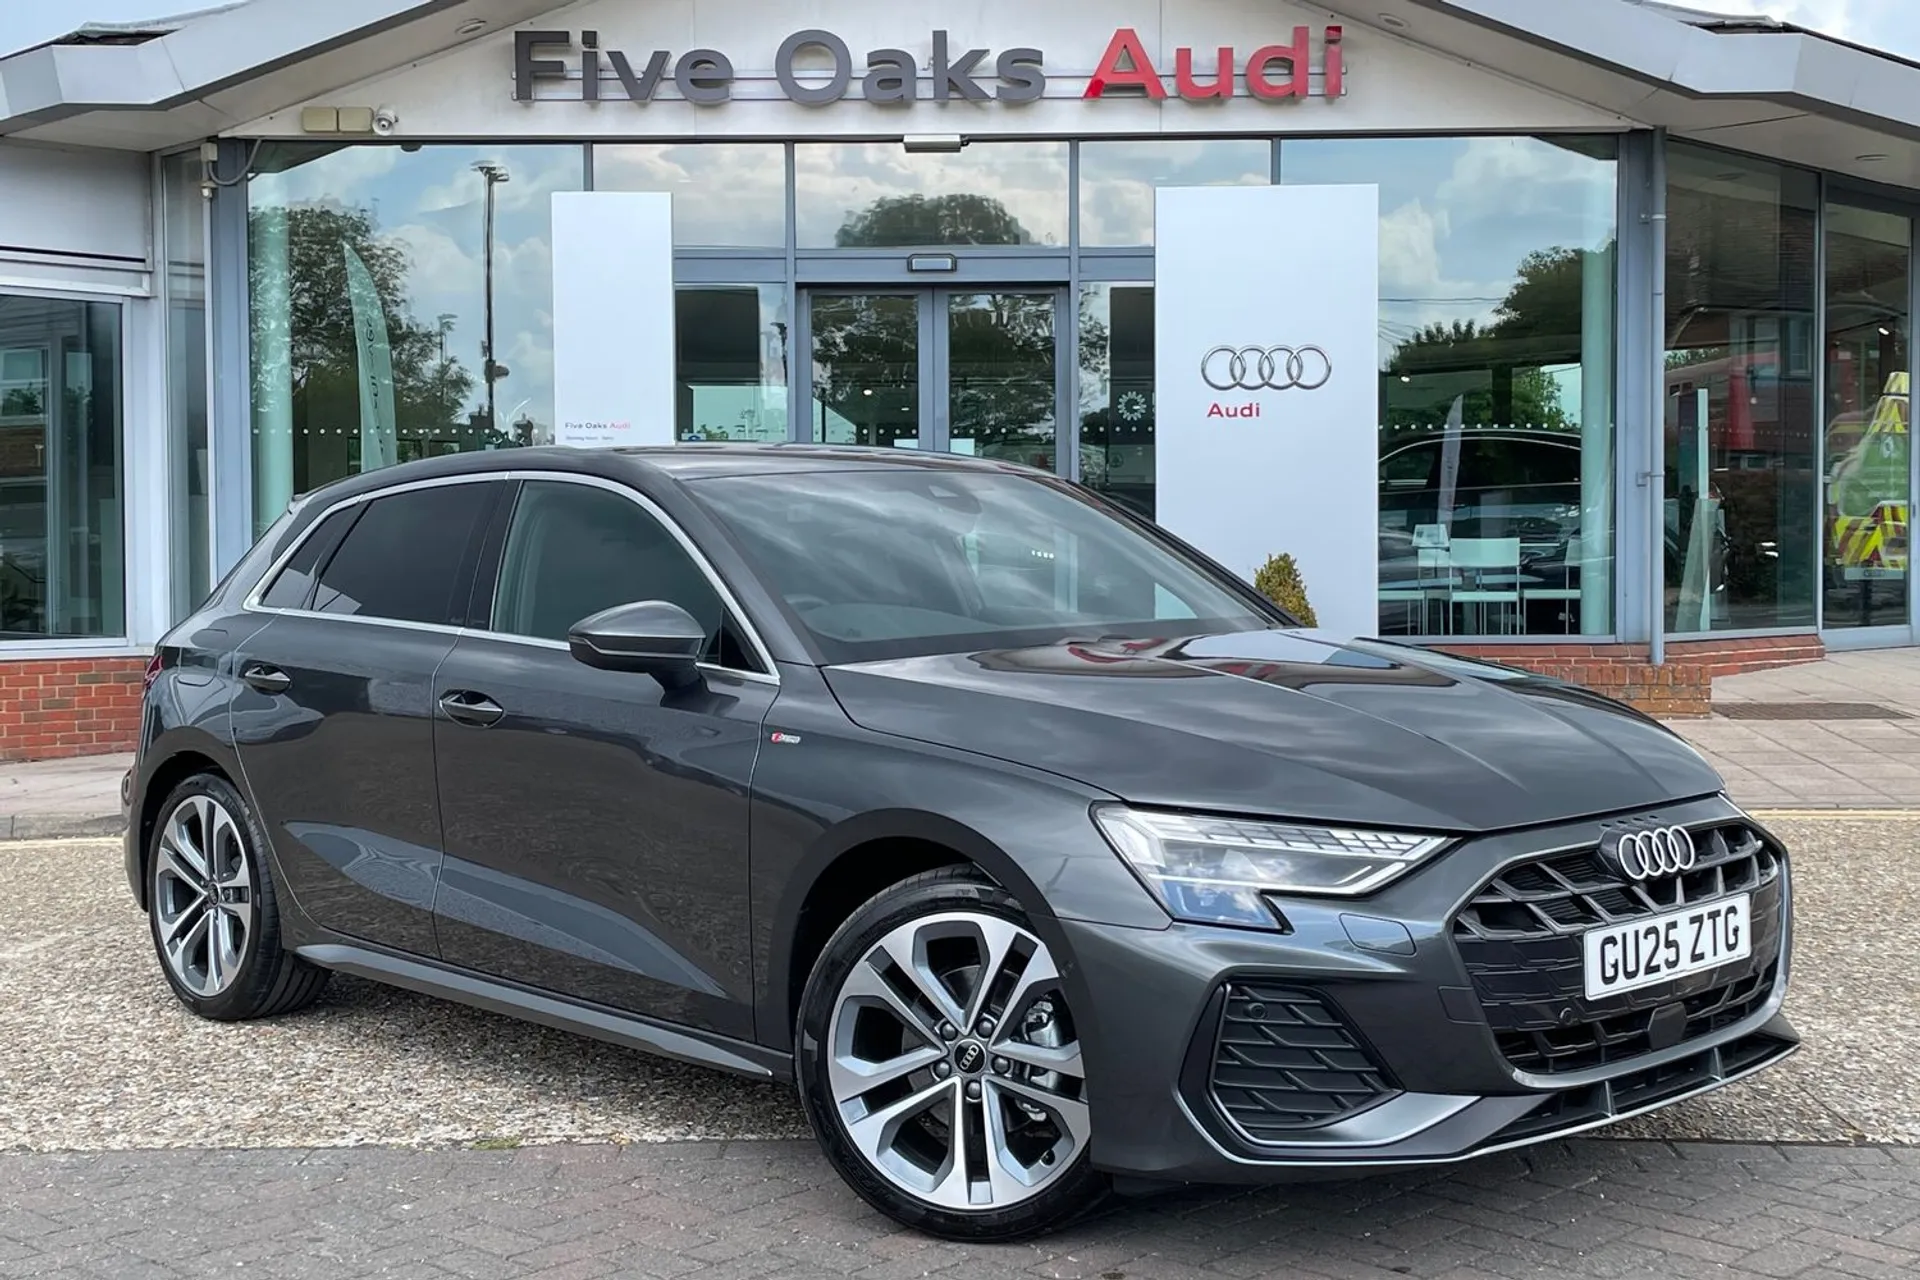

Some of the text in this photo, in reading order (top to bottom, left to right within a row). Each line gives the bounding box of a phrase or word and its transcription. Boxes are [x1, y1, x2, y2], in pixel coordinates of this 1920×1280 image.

[513, 25, 1344, 105] Five Oaks Audi
[1207, 402, 1260, 418] Audi
[1600, 905, 1740, 985] GU25 ZTG
